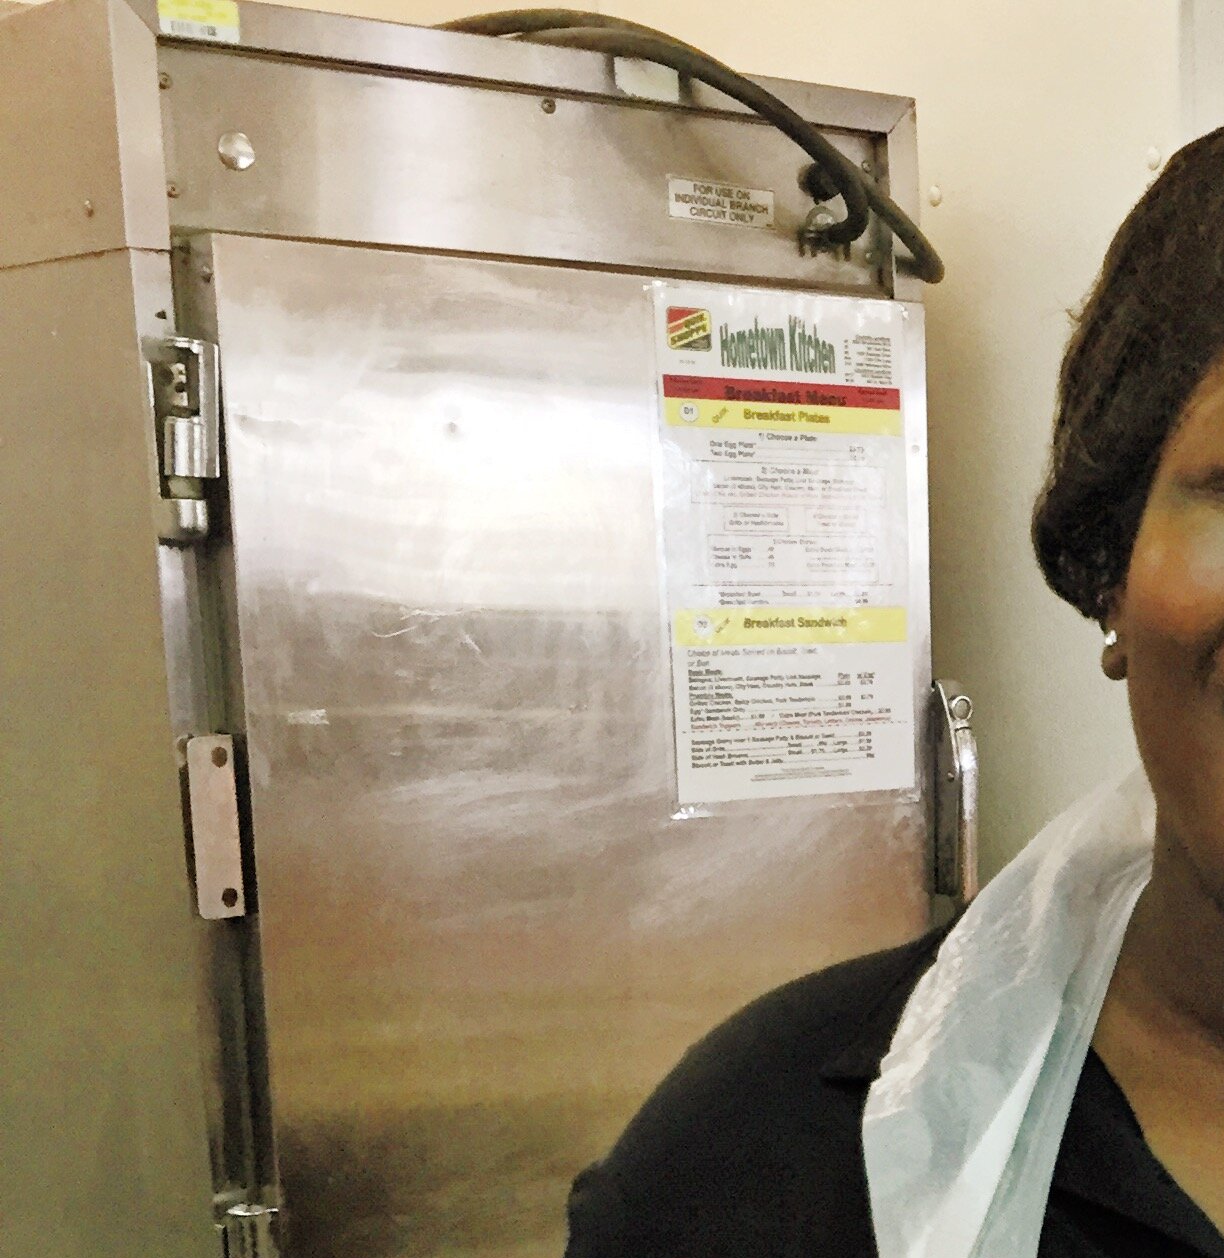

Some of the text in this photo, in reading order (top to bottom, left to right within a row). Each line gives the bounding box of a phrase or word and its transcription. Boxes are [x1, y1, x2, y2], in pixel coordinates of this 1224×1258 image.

[693, 182, 751, 200] FOR USE ON
[674, 192, 769, 214] INDIVIDUAL BRANCH
[689, 206, 755, 224] CIRCUIT ONLY
[719, 313, 787, 371] Hometown
[788, 313, 837, 374] Kitchen
[724, 385, 801, 404] Breakfast
[743, 407, 831, 424] Breakfast Plates
[743, 615, 848, 629] Breakfast Sandwich
